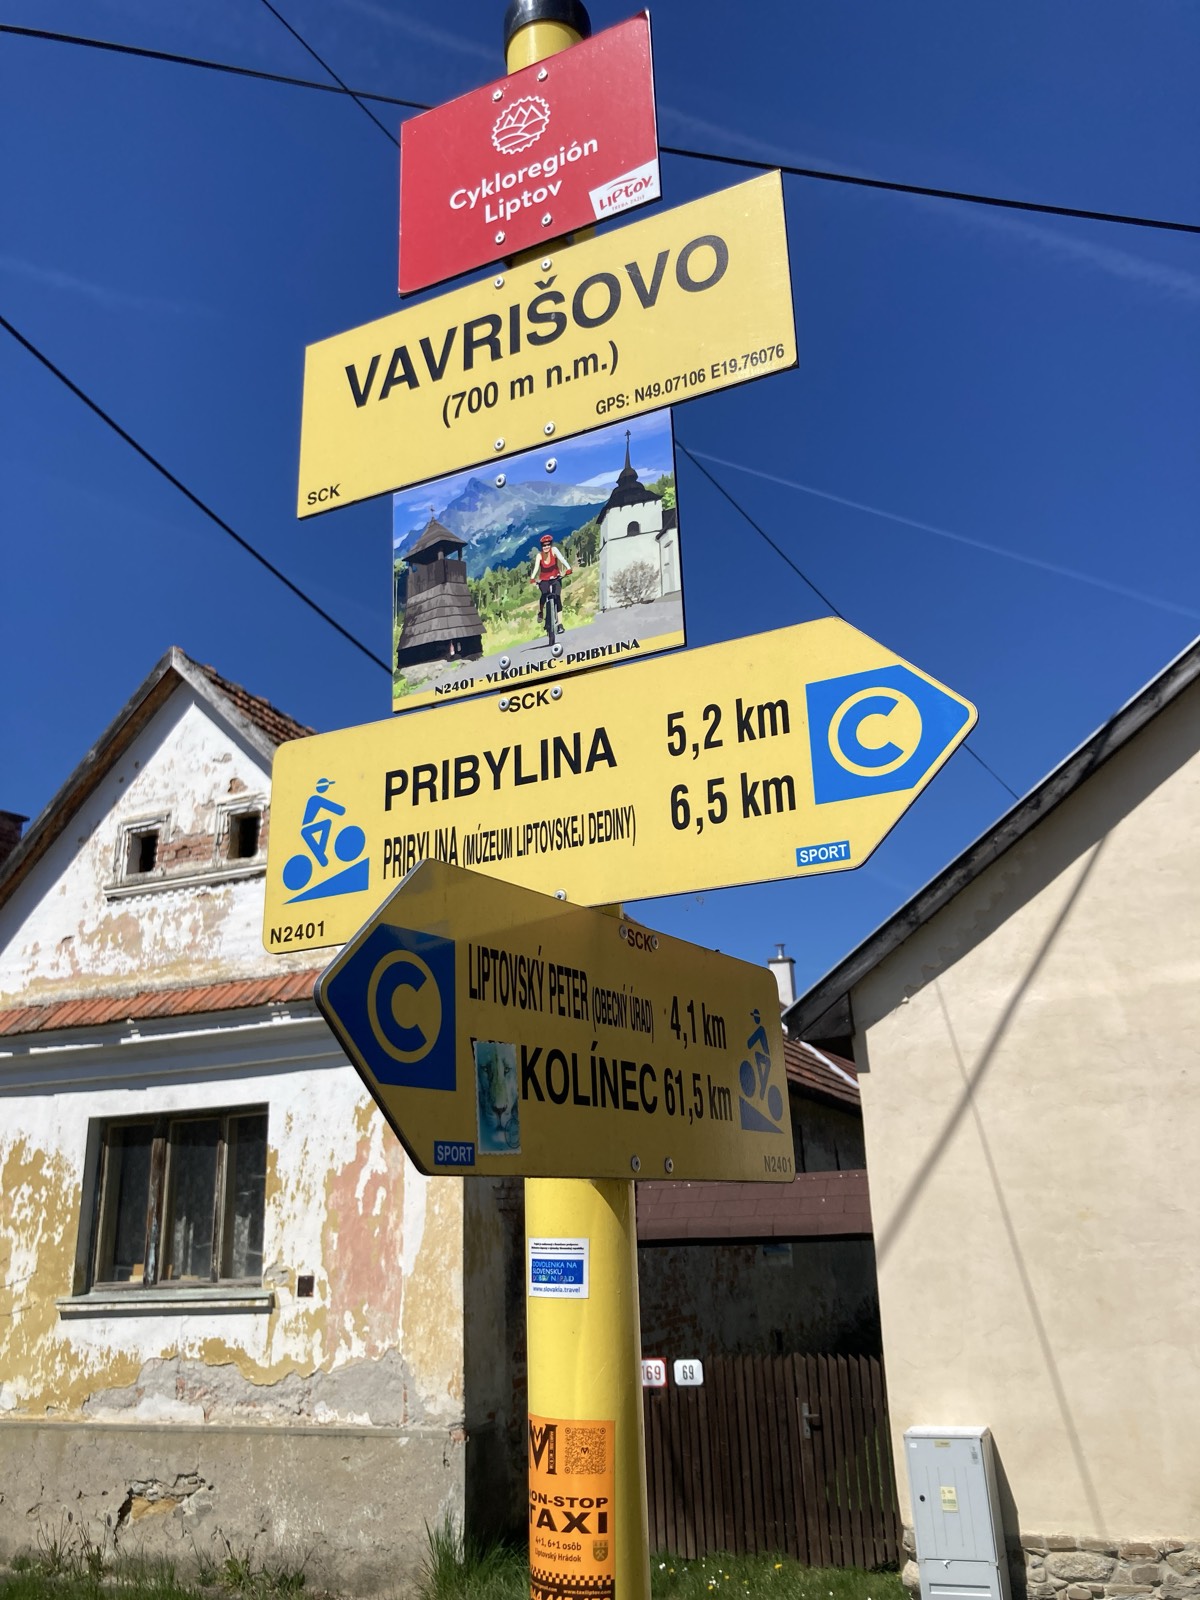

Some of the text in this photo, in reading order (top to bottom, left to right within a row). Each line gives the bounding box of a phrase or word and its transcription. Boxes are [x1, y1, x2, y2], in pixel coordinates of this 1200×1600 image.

[449, 138, 599, 210] Cykloregión
[484, 180, 563, 224] Liptov
[344, 233, 730, 409] VAVRIŠOVO
[442, 340, 620, 429] (700 m n.m.)
[595, 343, 785, 415] GPS: N49.07106 E19.76076
[307, 483, 341, 505] SCK
[434, 677, 475, 696] N2401
[485, 658, 557, 684] VLKOLÍNEC
[566, 638, 641, 666] PRIBYLINA
[507, 688, 551, 713] SCK
[384, 697, 791, 812] PRIBYLINA 5,2 km
[462, 823, 513, 869] (MÚZEUM
[516, 813, 585, 857] LIPTOVSKEJ
[588, 804, 637, 847] DEDINY)
[670, 776, 728, 835] 6,5
[740, 772, 797, 819] km
[799, 843, 848, 864] SPORT
[269, 920, 325, 945] N2401
[627, 928, 653, 953] SCK
[468, 943, 728, 1050] LIPTOVSKÝ PETER (OBECNÝ ÚRAD) 4,1 km
[470, 1037, 733, 1125] KOLÍNEC 61,5 km
[437, 1144, 473, 1162] SPORT
[763, 1155, 792, 1173] N2401
[566, 1261, 578, 1269] NA
[682, 1364, 695, 1381] 69
[547, 1539, 561, 1550] 6+1
[562, 1541, 582, 1551] osôb
[557, 1553, 582, 1562] Hrádok
